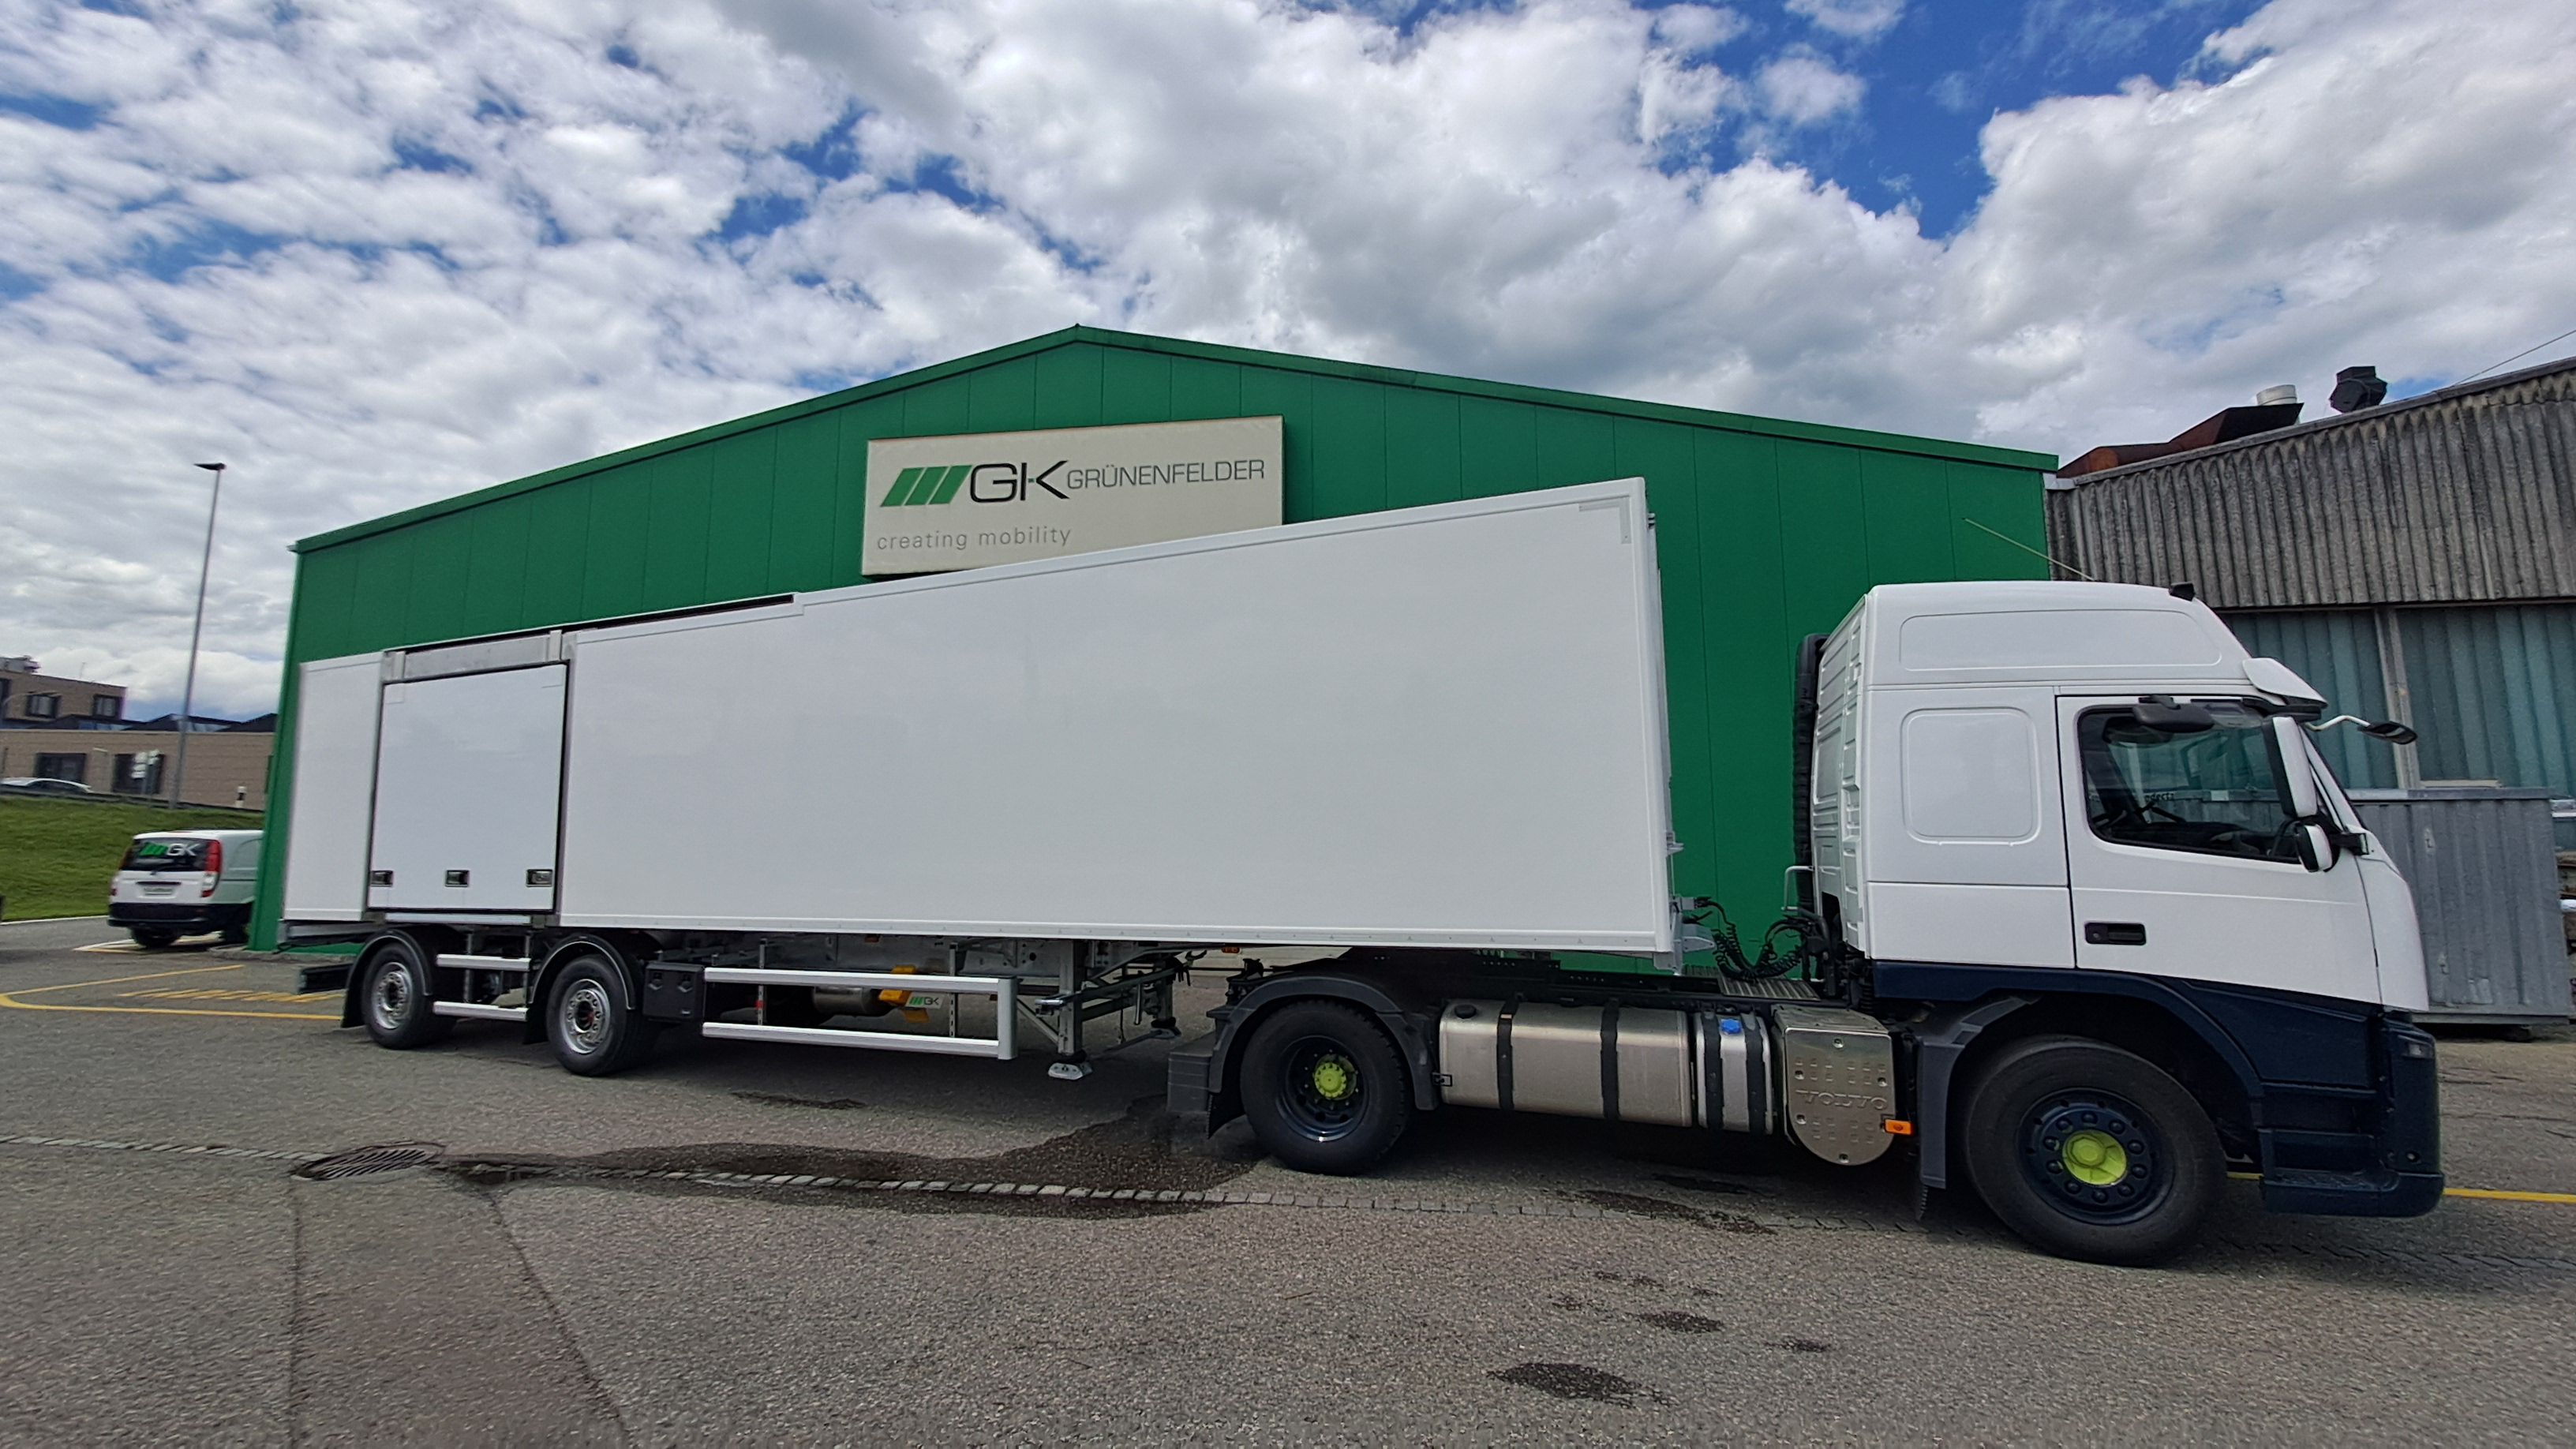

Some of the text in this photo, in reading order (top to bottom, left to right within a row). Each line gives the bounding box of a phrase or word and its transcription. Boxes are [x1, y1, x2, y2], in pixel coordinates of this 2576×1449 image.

[969, 459, 1265, 504] GK GRÜNENFELDER
[877, 526, 1071, 551] creating mobility
[167, 843, 200, 856] GK
[923, 997, 939, 1005] GK
[1795, 1090, 1888, 1110] VOLVO
